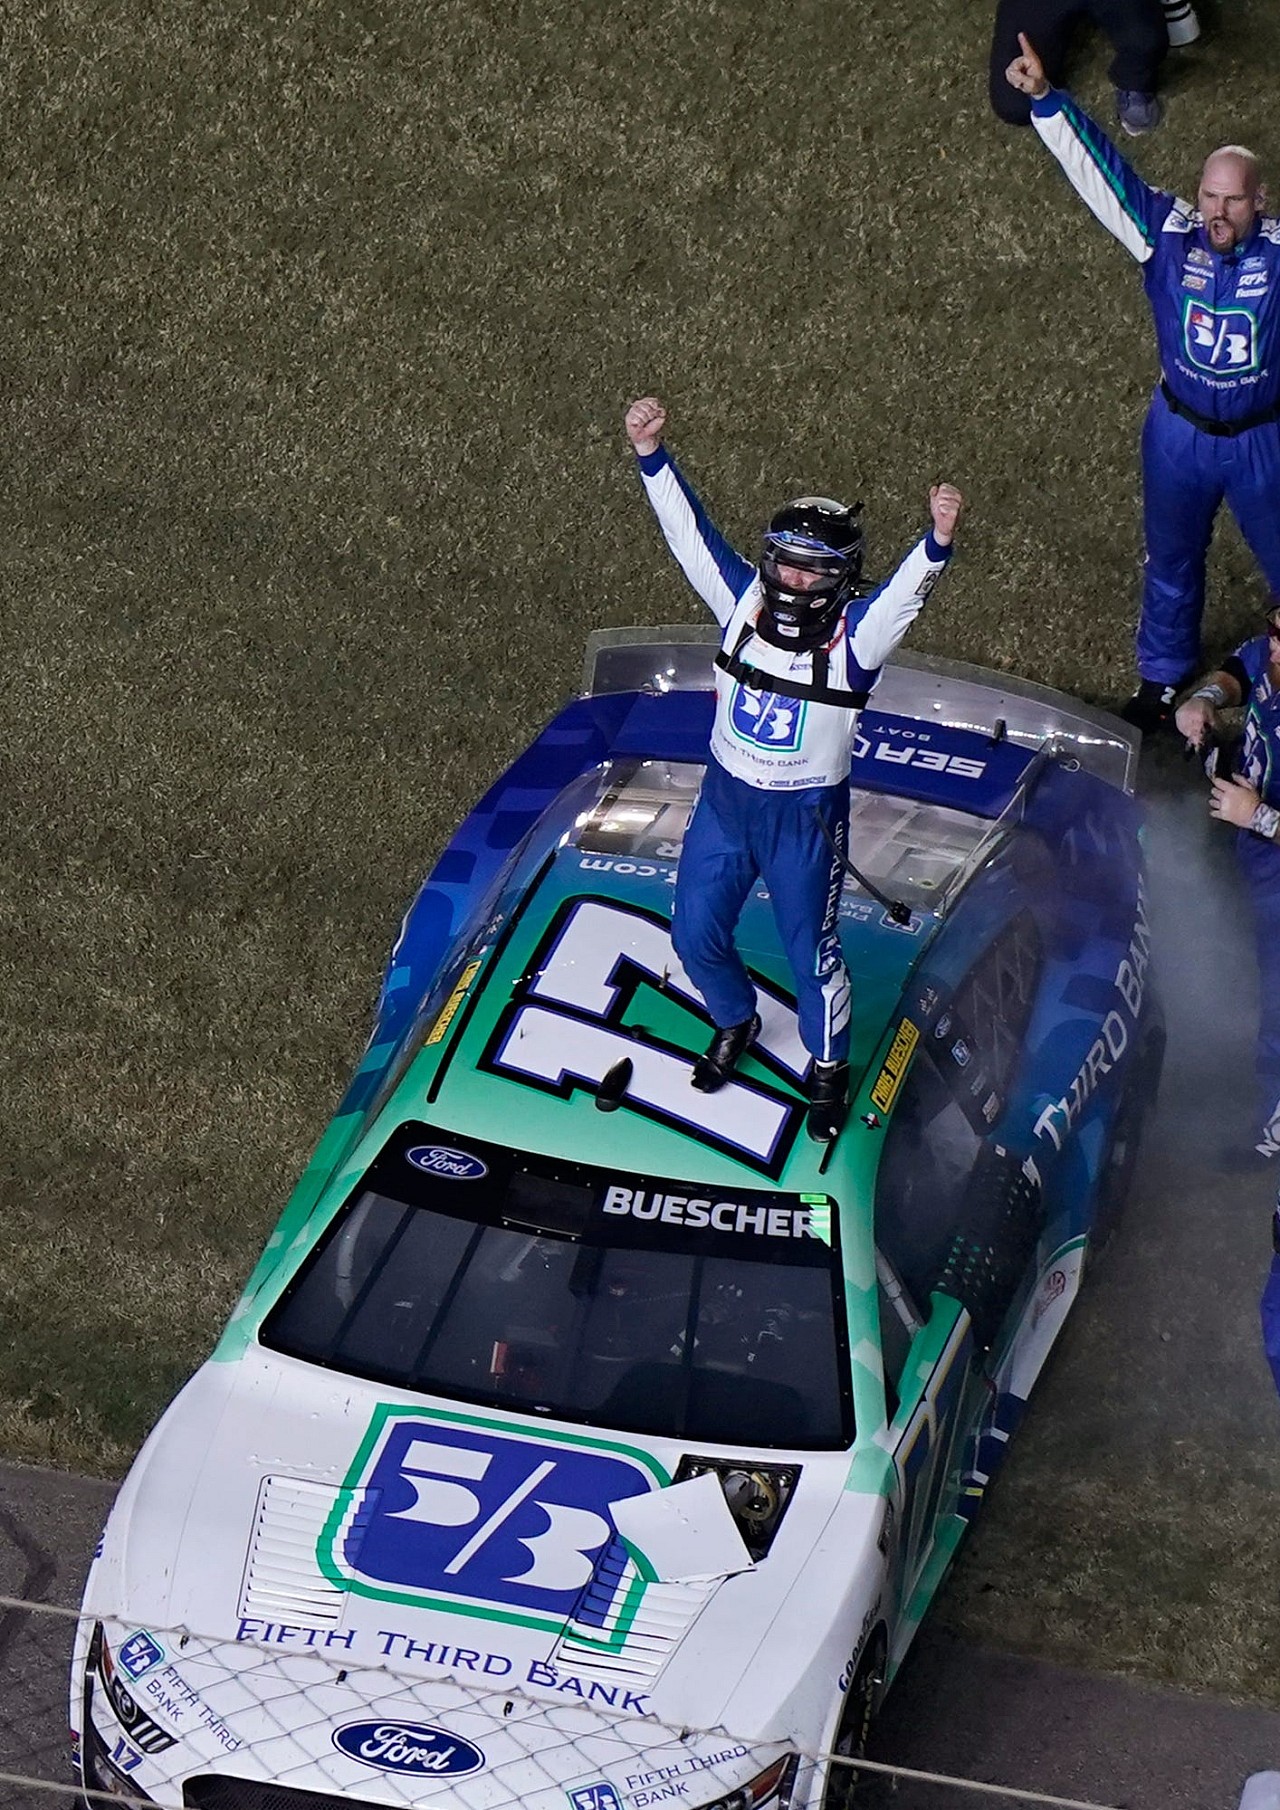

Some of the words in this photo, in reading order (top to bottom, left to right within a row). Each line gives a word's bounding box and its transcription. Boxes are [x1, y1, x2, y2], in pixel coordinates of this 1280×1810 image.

[872, 725, 931, 742] BOAT
[830, 821, 843, 880] THRD
[1032, 1009, 1128, 1152] THIRD
[414, 1146, 479, 1178] Ford
[602, 1185, 821, 1239] BUESCHER
[236, 1617, 354, 1650] FIFTH
[377, 1630, 512, 1677] THIRD
[526, 1659, 652, 1718] BANK
[146, 1679, 184, 1722] BANK
[162, 1665, 200, 1707] FIFTH
[199, 1704, 242, 1752] THIRD
[111, 1736, 144, 1773] 17
[356, 1723, 459, 1772] Ford
[625, 1764, 681, 1790] FIFTH
[685, 1744, 748, 1771] THIRD
[633, 1781, 690, 1808] BANK
